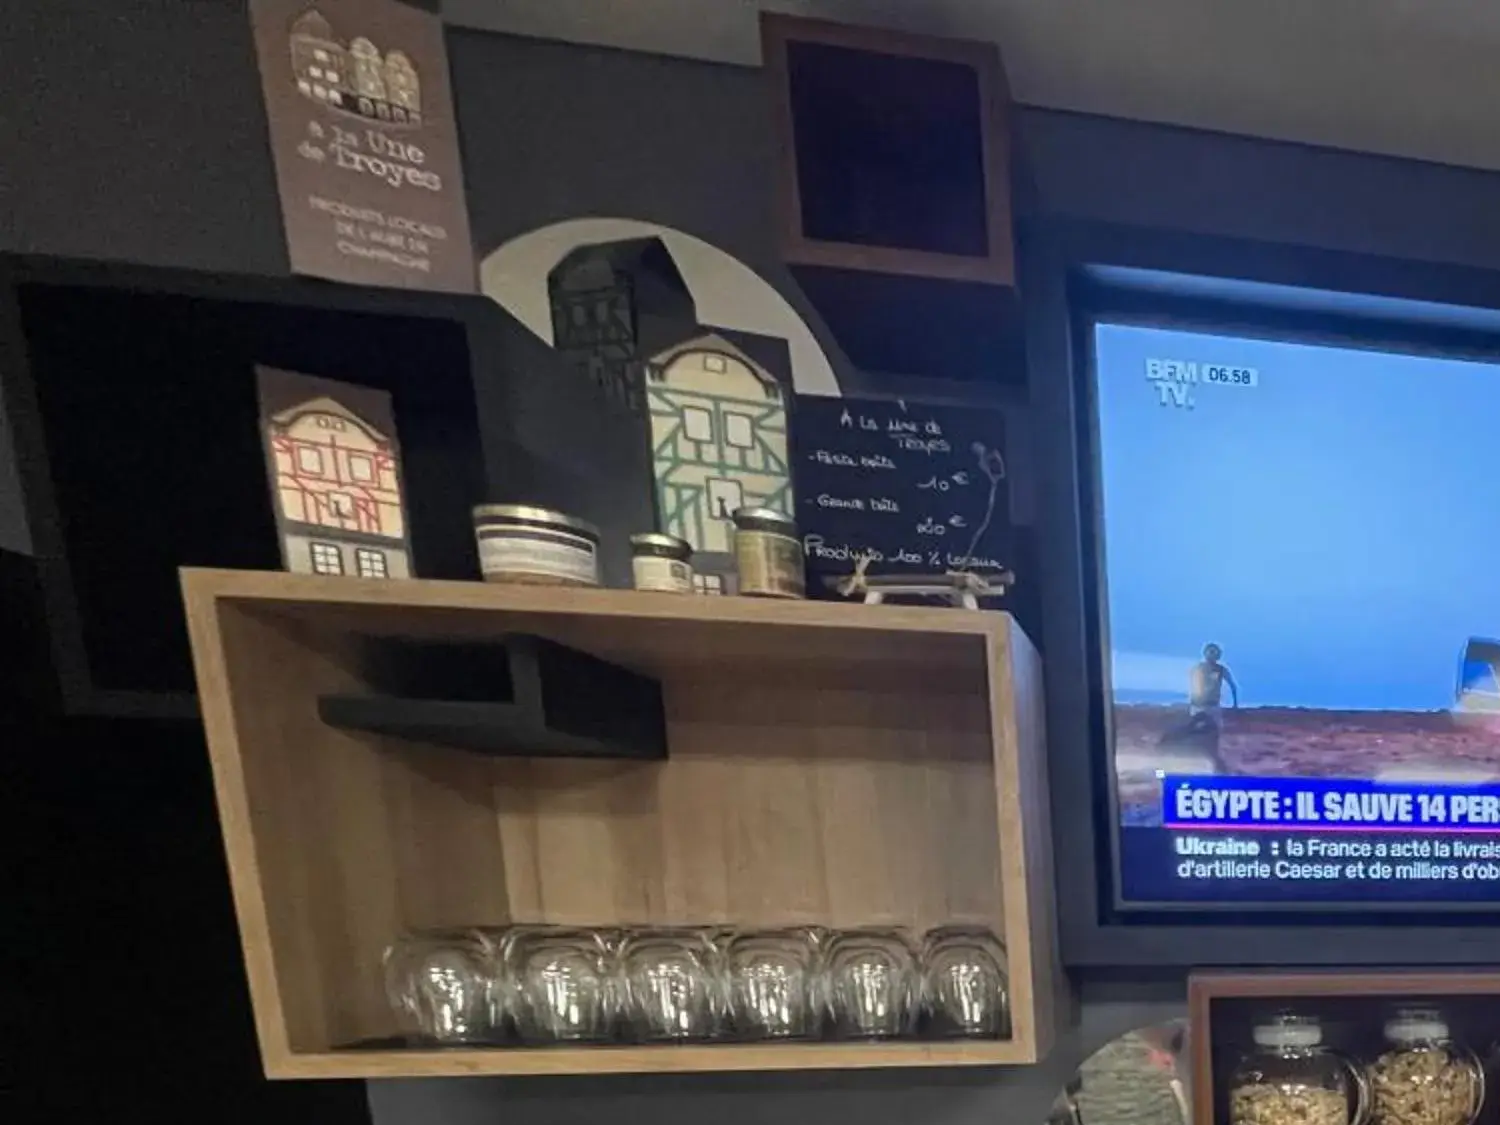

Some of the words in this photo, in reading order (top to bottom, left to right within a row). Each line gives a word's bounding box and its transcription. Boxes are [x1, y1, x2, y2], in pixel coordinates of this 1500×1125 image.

[1145, 358, 1198, 384] BFM
[1176, 783, 1281, 820] ÉGYPTE
[1284, 797, 1293, 820] :
[1296, 791, 1321, 820] IL
[1323, 791, 1414, 822] SAUVE
[1417, 794, 1448, 823] 14
[1175, 837, 1261, 856] Ukraine
[1286, 840, 1305, 858] la
[1307, 840, 1371, 858] France
[1374, 845, 1388, 857] a
[1390, 841, 1431, 858] acté
[1434, 841, 1451, 859] la
[1177, 860, 1271, 878] d'artillerie
[1275, 861, 1342, 879] Caesar
[1345, 862, 1366, 879] et
[1368, 862, 1394, 879] de
[1395, 863, 1459, 880] milliers
